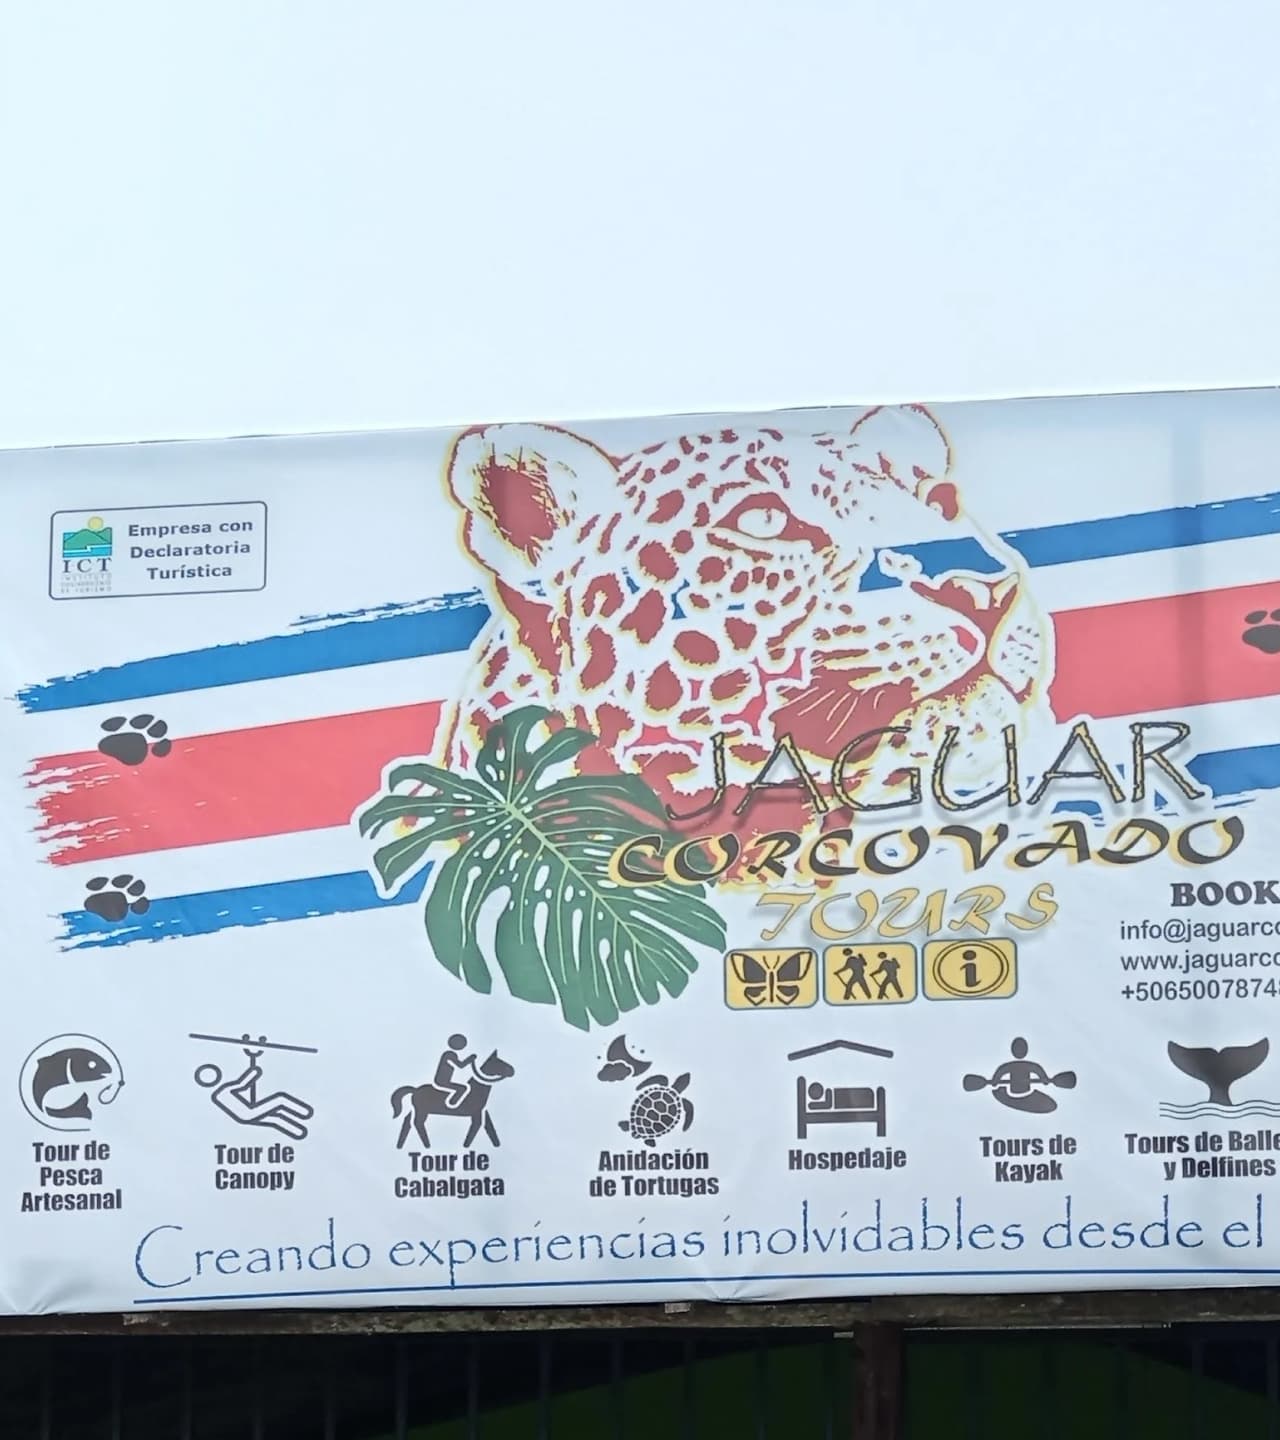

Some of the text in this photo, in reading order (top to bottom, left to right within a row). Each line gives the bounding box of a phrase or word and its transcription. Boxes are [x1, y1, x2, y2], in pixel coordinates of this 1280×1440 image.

[128, 521, 253, 538] Empresa con
[130, 540, 251, 559] Declaratoria
[147, 564, 232, 580] Turística
[665, 721, 1206, 822] JAGUAR
[610, 814, 1244, 888] CORCOVADO
[756, 882, 1058, 942] TOURS
[32, 1141, 110, 1163] Tour de
[215, 1143, 295, 1165] Tour de
[980, 1134, 1077, 1158] Tours de
[1124, 1133, 1189, 1155] Tours
[1194, 1131, 1223, 1153] de
[408, 1151, 489, 1173] Tour de
[598, 1148, 709, 1173] Anidación
[788, 1148, 907, 1172] Hospedaje
[995, 1159, 1063, 1183] Kayak
[1163, 1156, 1276, 1181] y Delfines
[40, 1166, 103, 1187] Pesca
[215, 1169, 295, 1193] Canopy
[394, 1176, 505, 1199] Cabalgata
[589, 1174, 719, 1197] de Tortugas
[20, 1189, 123, 1213] Artesanal
[135, 1217, 371, 1288] Creando
[389, 1217, 704, 1289] experiencias
[722, 1196, 1023, 1258] inolvidables
[1043, 1195, 1204, 1249] desde
[1222, 1194, 1262, 1249] el
